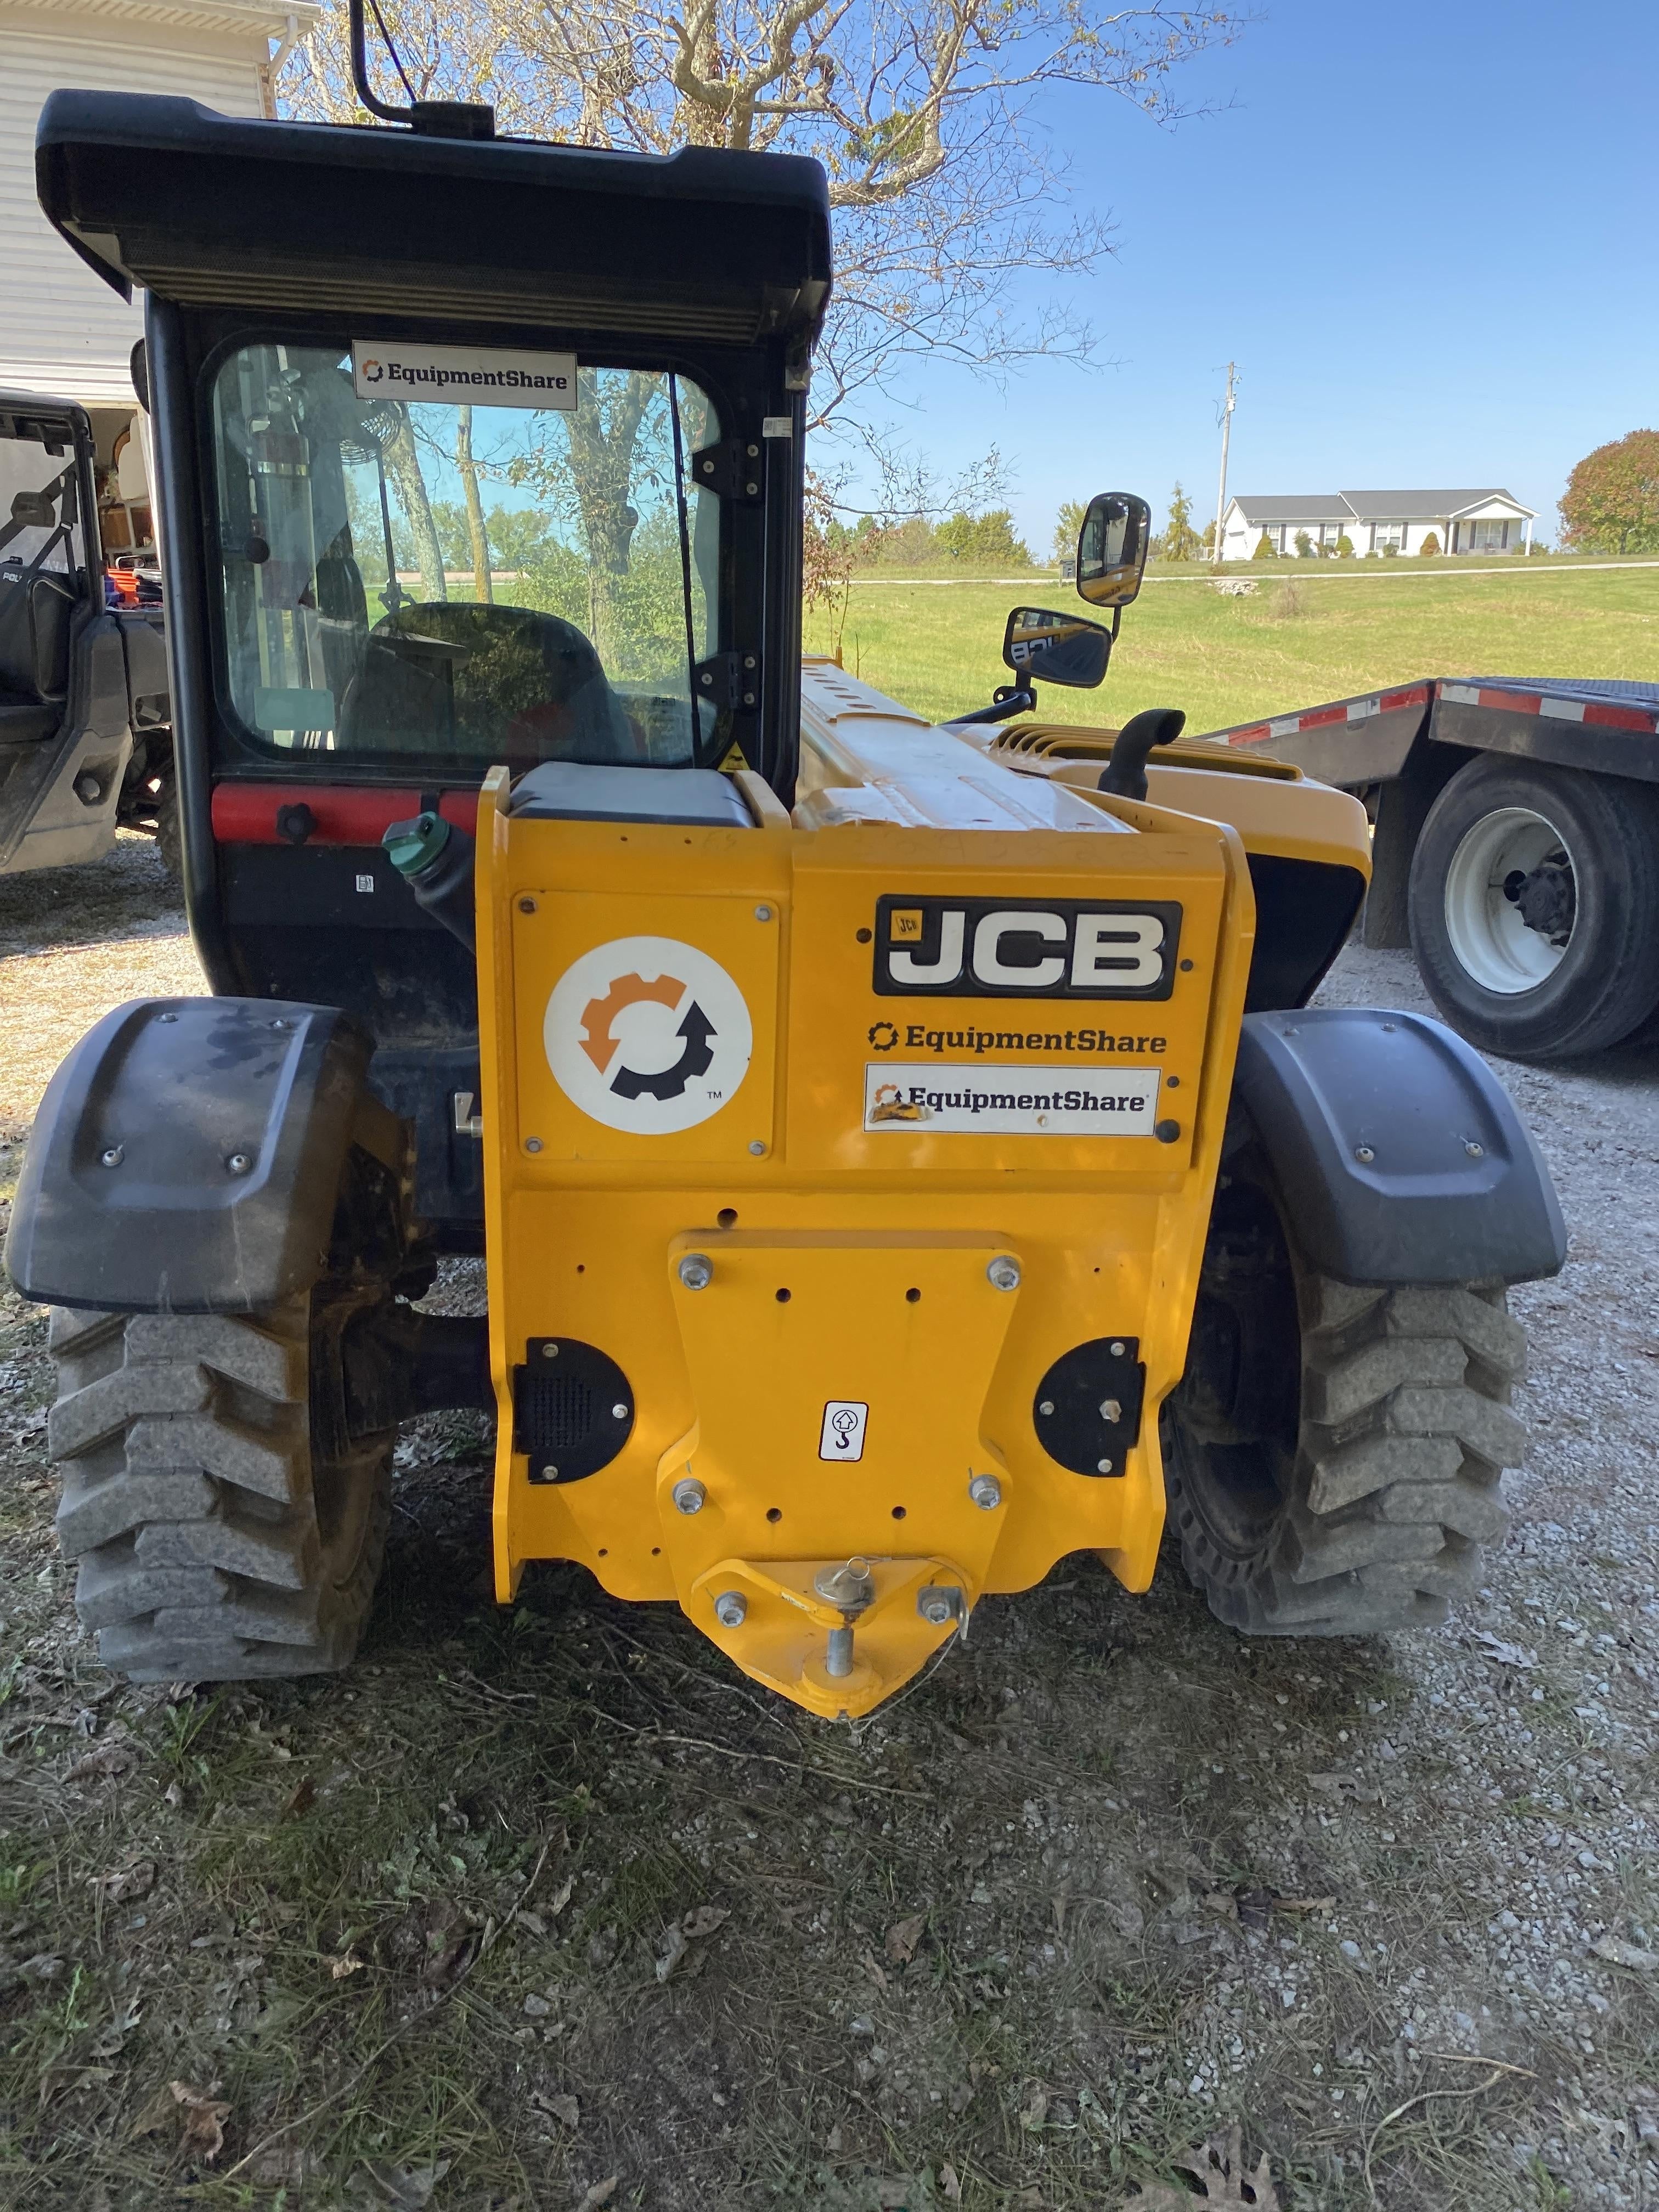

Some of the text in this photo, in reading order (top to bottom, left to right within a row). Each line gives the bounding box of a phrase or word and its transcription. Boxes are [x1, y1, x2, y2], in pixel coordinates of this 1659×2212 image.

[387, 363, 567, 389] EquipmentShare
[900, 917, 917, 933] JCB
[889, 911, 1164, 987] JCB
[906, 1025, 1167, 1054] EquipmentShare
[707, 1091, 722, 1099] TM
[909, 1087, 1145, 1113] EquipmentShare
